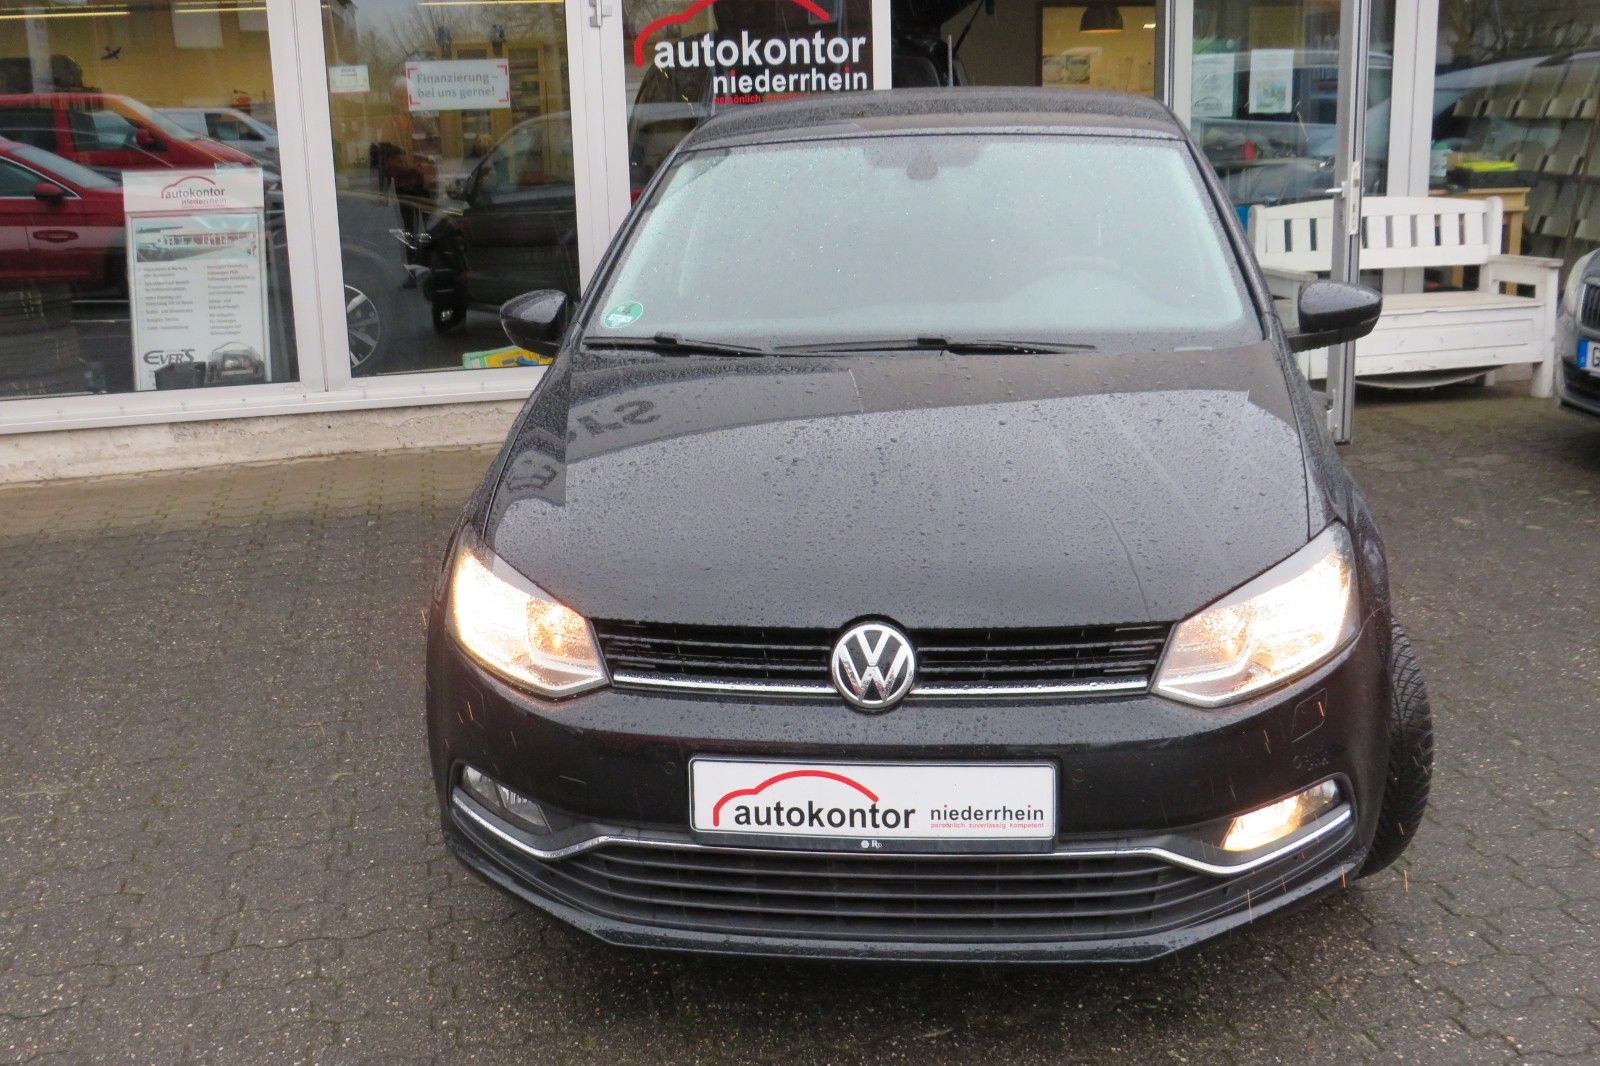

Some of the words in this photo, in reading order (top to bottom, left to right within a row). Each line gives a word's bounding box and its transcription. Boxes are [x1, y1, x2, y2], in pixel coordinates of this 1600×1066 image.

[653, 30, 867, 69] autokontor
[416, 73, 489, 85] Finanzierung
[712, 67, 868, 94] niederrhein
[417, 88, 436, 98] bei
[439, 87, 456, 98] uns
[458, 85, 496, 99] gerne!
[165, 188, 226, 199] autokontor
[834, 625, 913, 707] VW
[734, 800, 915, 829] autokontor
[930, 804, 1044, 821] niederrhein
[930, 822, 966, 830] persönlich
[969, 822, 1006, 830] zuverlässig
